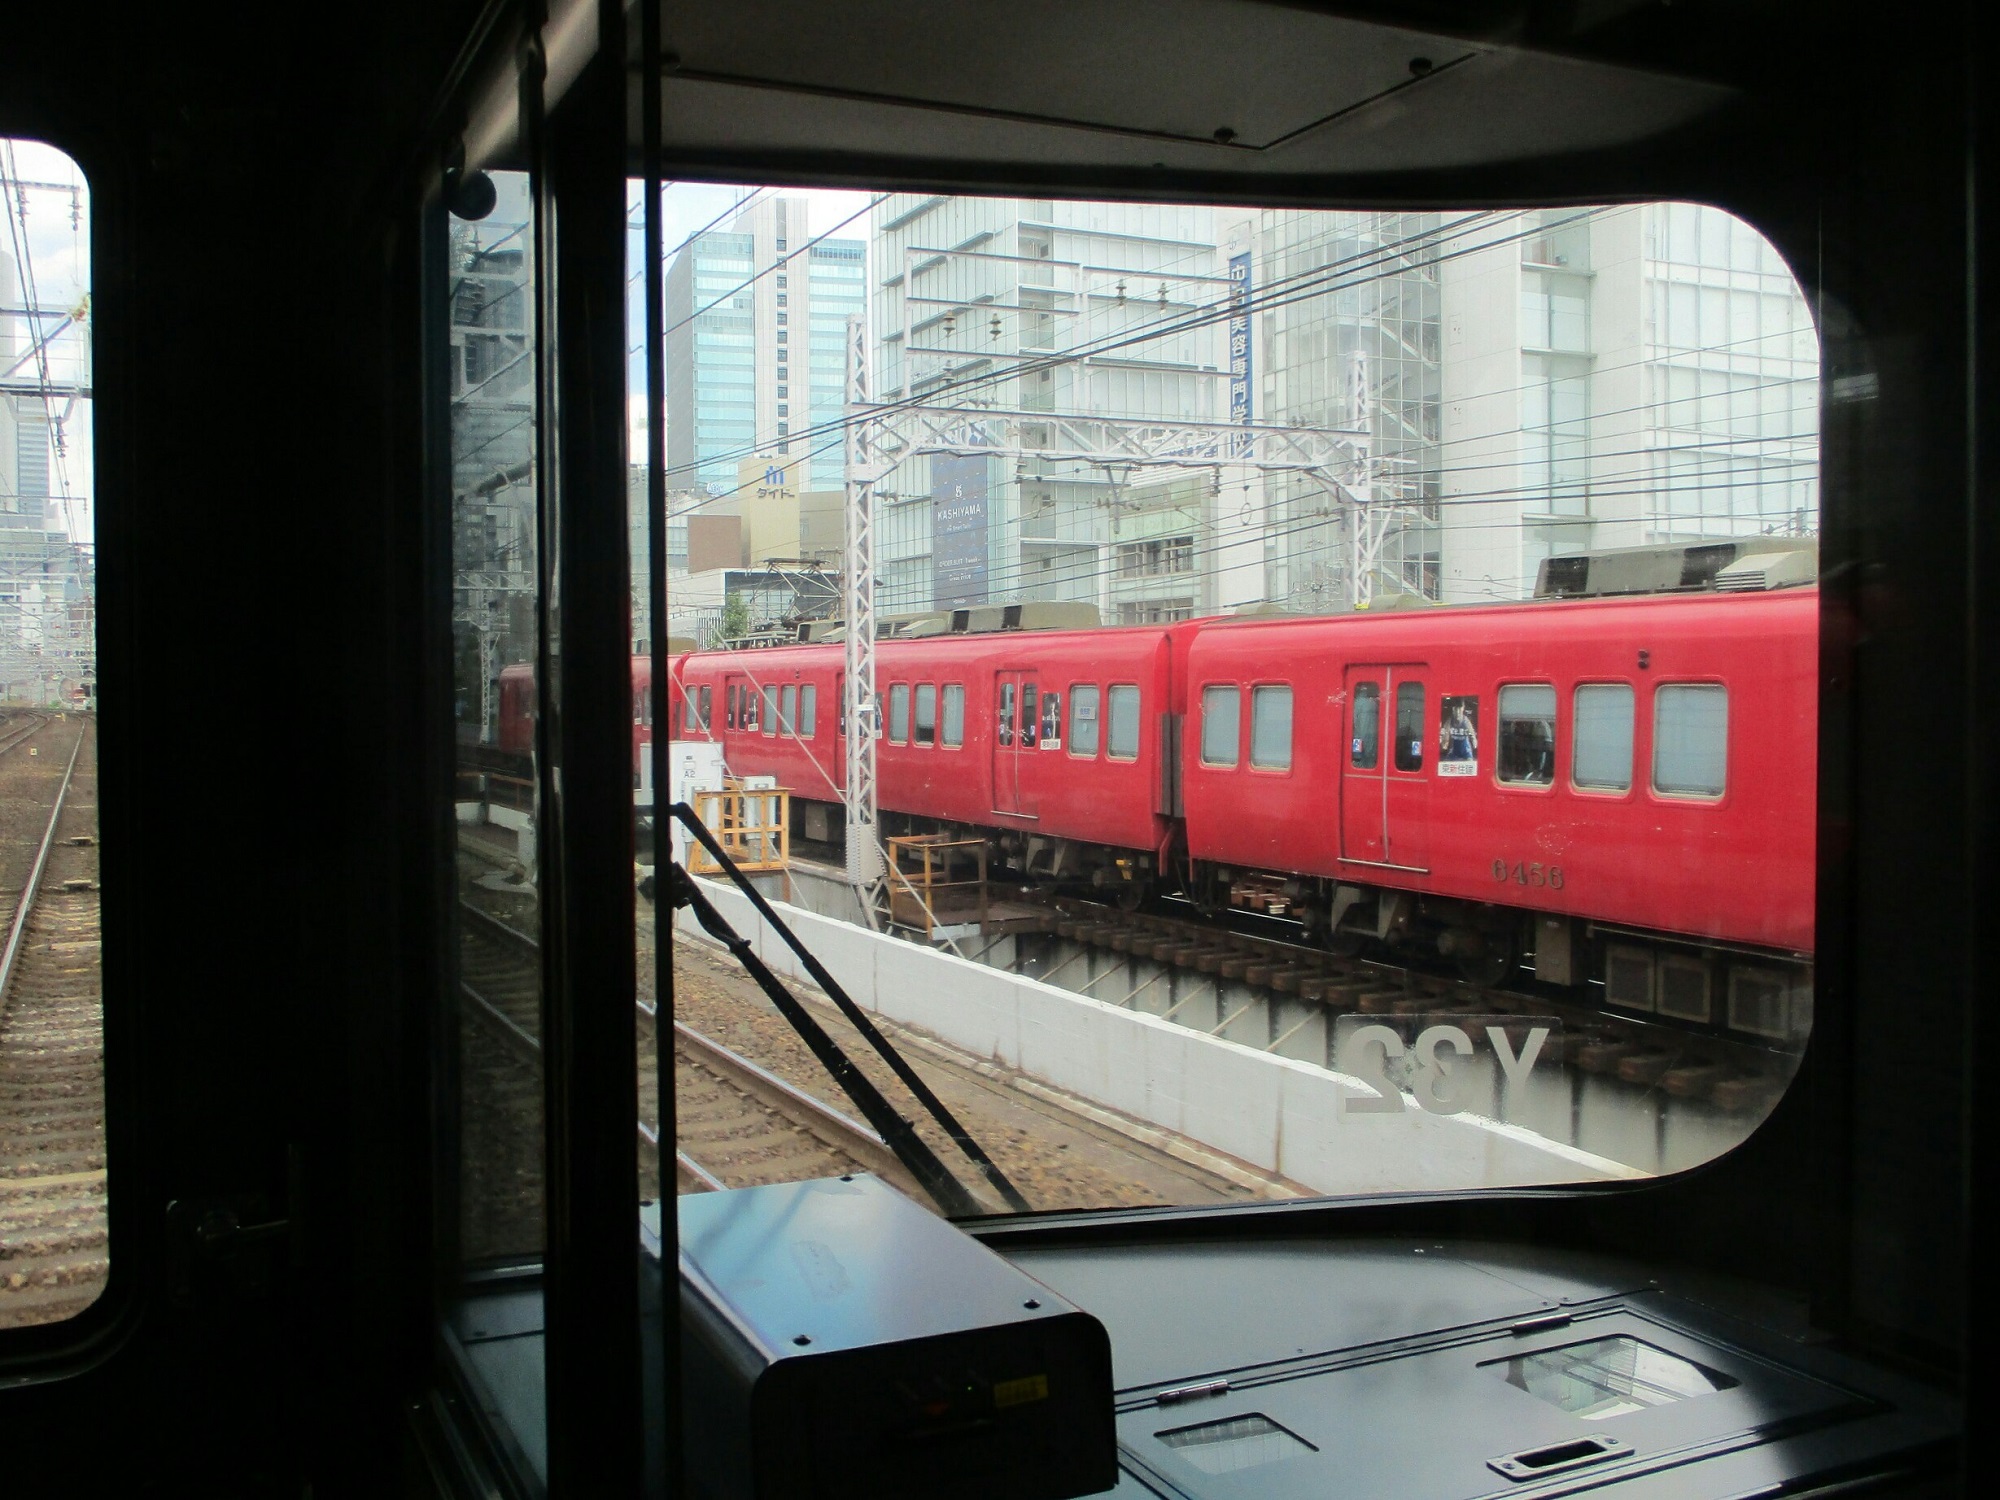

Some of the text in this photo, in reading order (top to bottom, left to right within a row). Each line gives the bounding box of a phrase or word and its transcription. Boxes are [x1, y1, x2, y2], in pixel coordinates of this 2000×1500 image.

[937, 503, 981, 521] KASHIYAMA
[684, 770, 696, 778] A2
[1491, 858, 1564, 890] 6456
